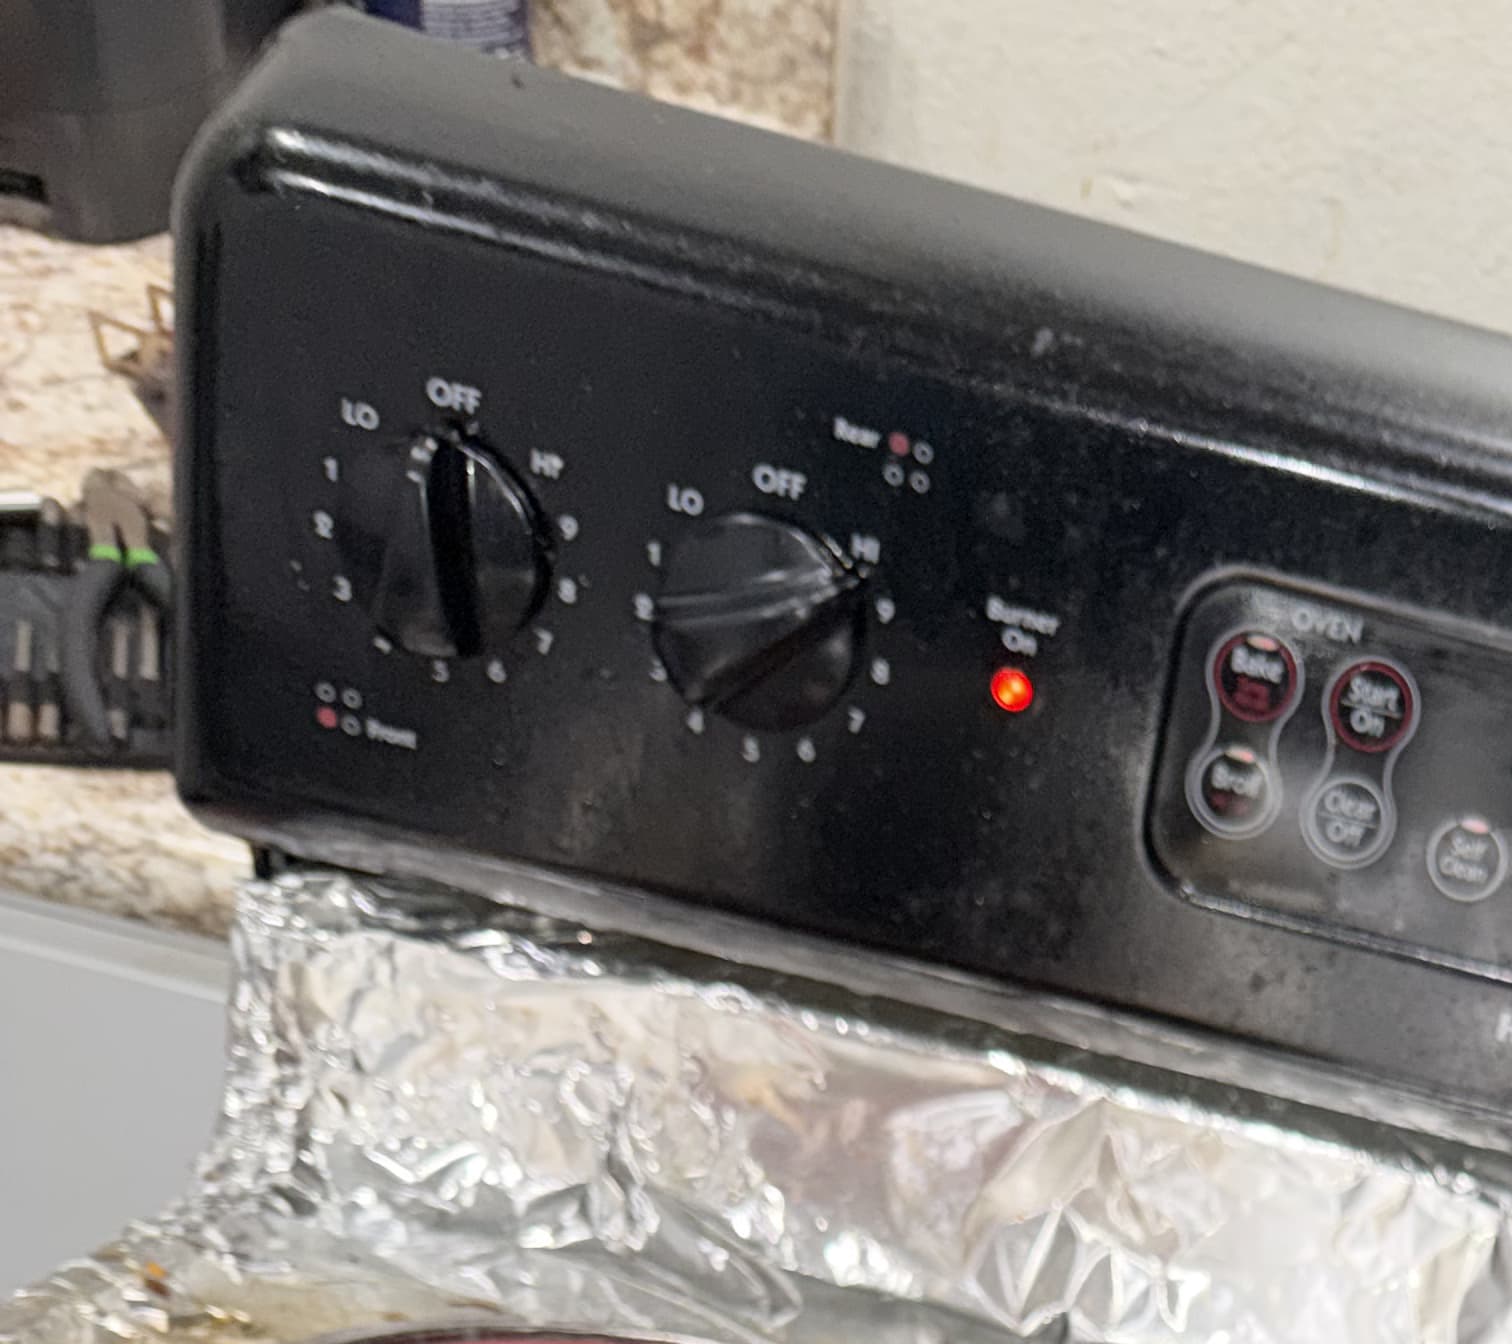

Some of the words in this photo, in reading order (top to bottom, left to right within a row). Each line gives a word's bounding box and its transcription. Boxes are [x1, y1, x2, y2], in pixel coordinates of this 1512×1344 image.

[341, 397, 379, 430] LO
[426, 377, 482, 415] OFF
[666, 483, 704, 516] LO
[752, 463, 808, 500] OFF
[1292, 603, 1362, 644] OVEN
[1230, 644, 1284, 685] Bake
[1348, 670, 1401, 712] Start
[1350, 710, 1385, 739] On
